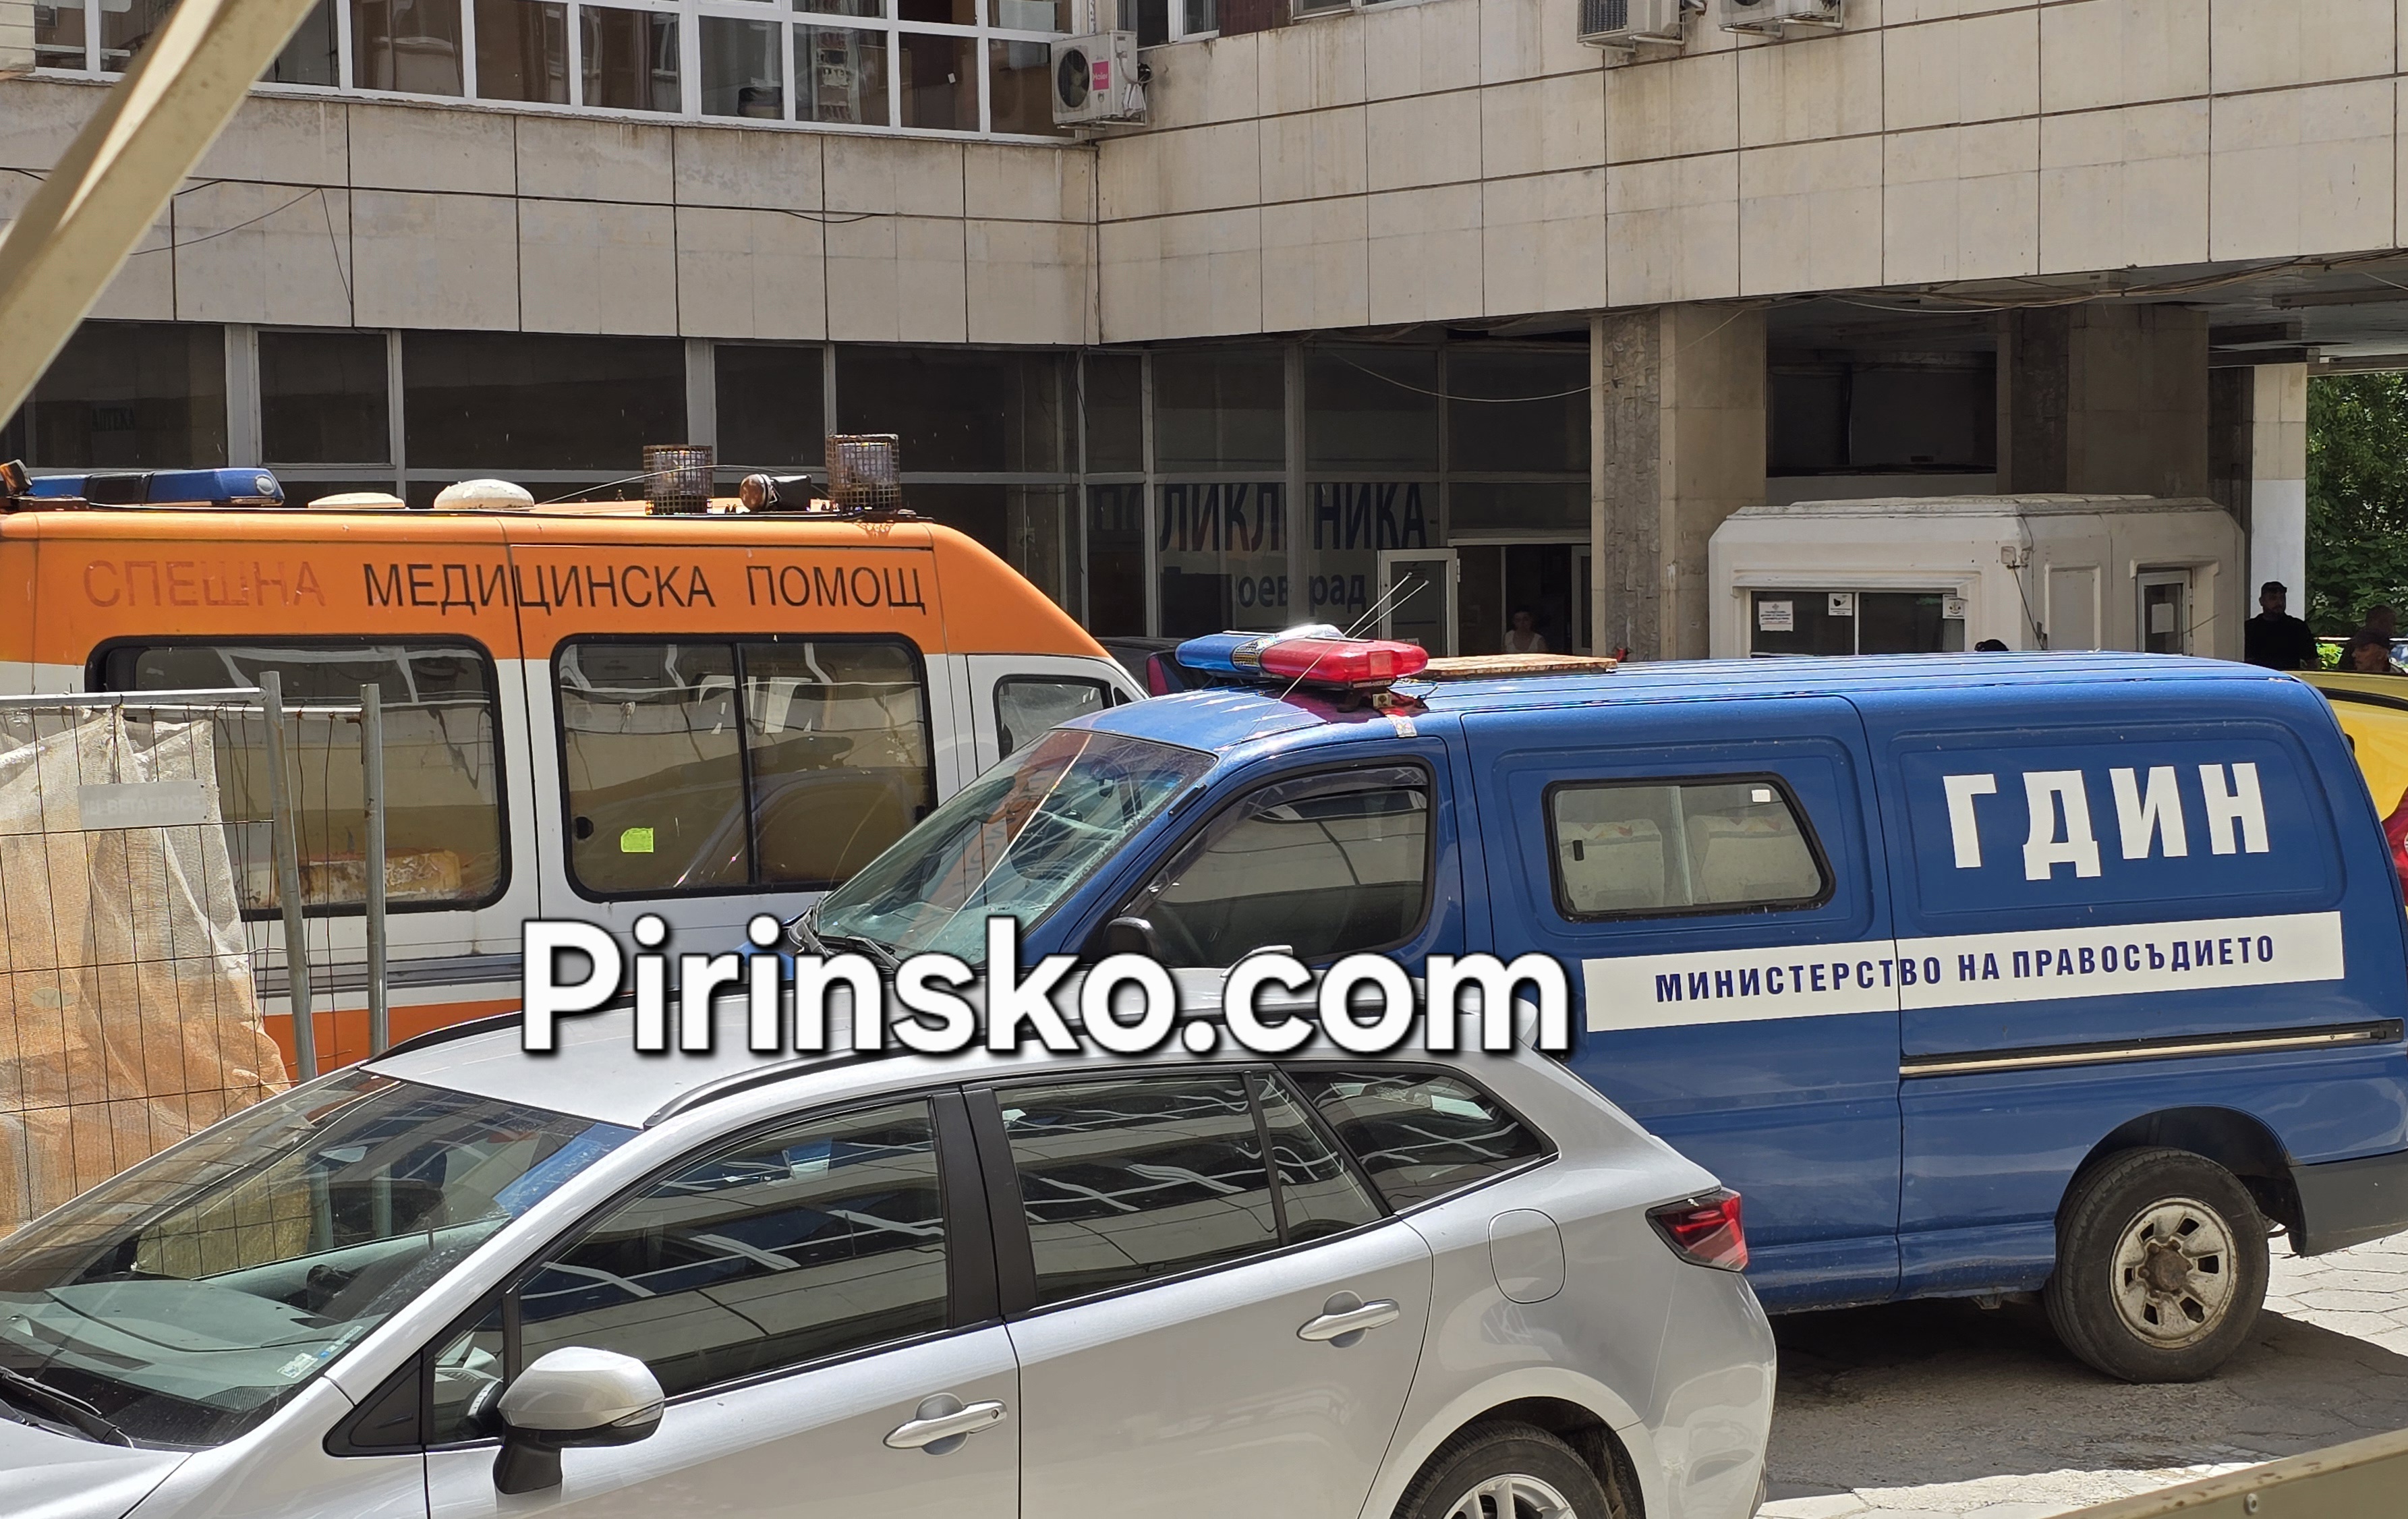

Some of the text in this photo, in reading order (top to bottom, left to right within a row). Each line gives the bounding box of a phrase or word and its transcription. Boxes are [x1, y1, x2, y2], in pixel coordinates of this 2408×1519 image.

[1094, 483, 1427, 552] ПЛИКЛНИКА
[83, 560, 927, 617] СПЕШНА МЕДИЦИНСКА ПОМОЩ
[107, 795, 202, 815] BETAFENCE
[1943, 762, 2269, 880] ГДИН
[1656, 935, 2274, 1003] МИНИСТЕРСТВО НА ПРАВОСЪДИЕТО
